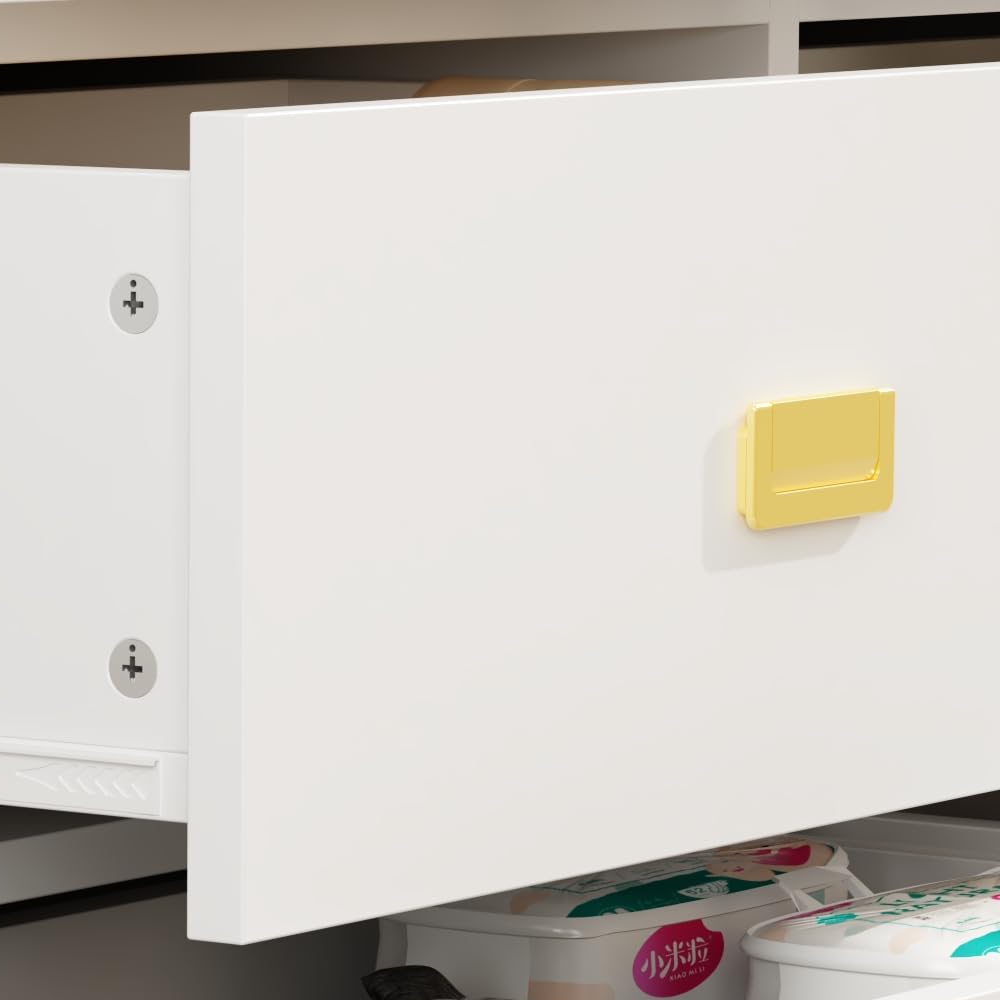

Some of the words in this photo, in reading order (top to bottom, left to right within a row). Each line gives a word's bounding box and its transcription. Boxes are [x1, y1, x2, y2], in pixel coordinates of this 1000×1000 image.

[640, 937, 709, 979] 小米粒
[669, 971, 687, 981] XIAO
